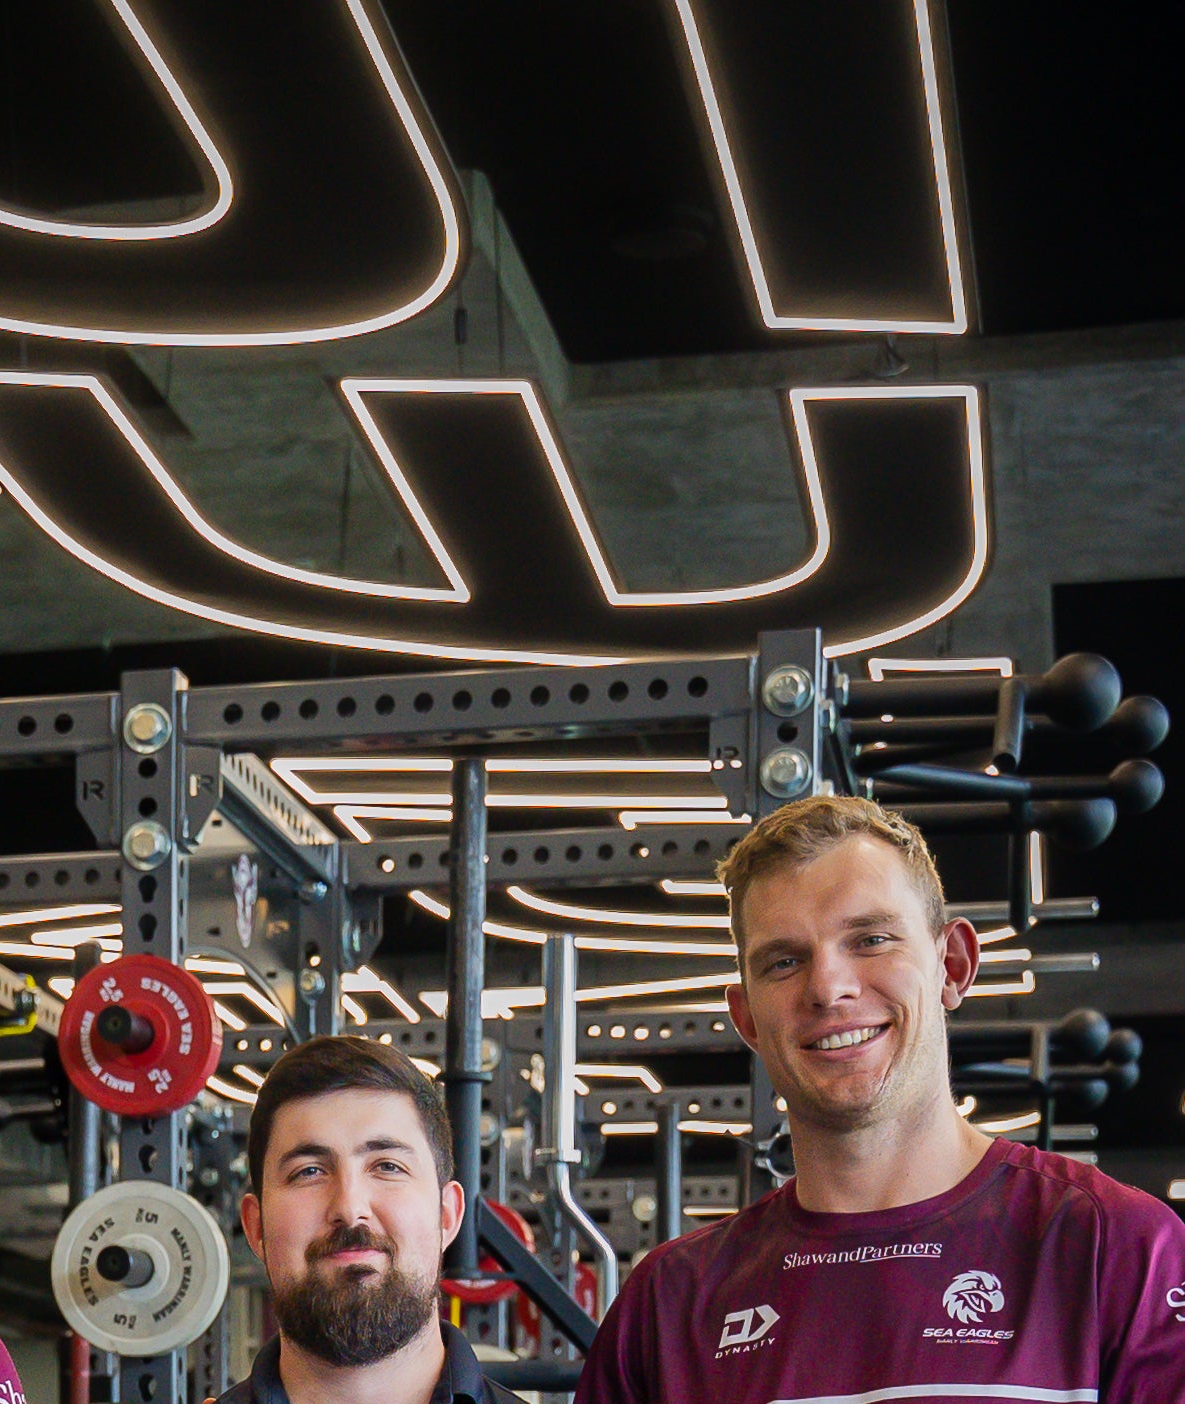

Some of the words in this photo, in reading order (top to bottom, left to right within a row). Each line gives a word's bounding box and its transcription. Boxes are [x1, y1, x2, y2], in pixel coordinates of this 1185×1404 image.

[140, 977, 190, 1020] EAGLES
[89, 1217, 115, 1243] SEA
[145, 1212, 158, 1224] 5
[783, 1242, 942, 1270] ShawandPartners
[79, 1246, 100, 1306] EAGLES
[922, 1327, 953, 1338] SEA
[955, 1328, 1014, 1340] EAGLES
[715, 1337, 776, 1359] DYNASTY
